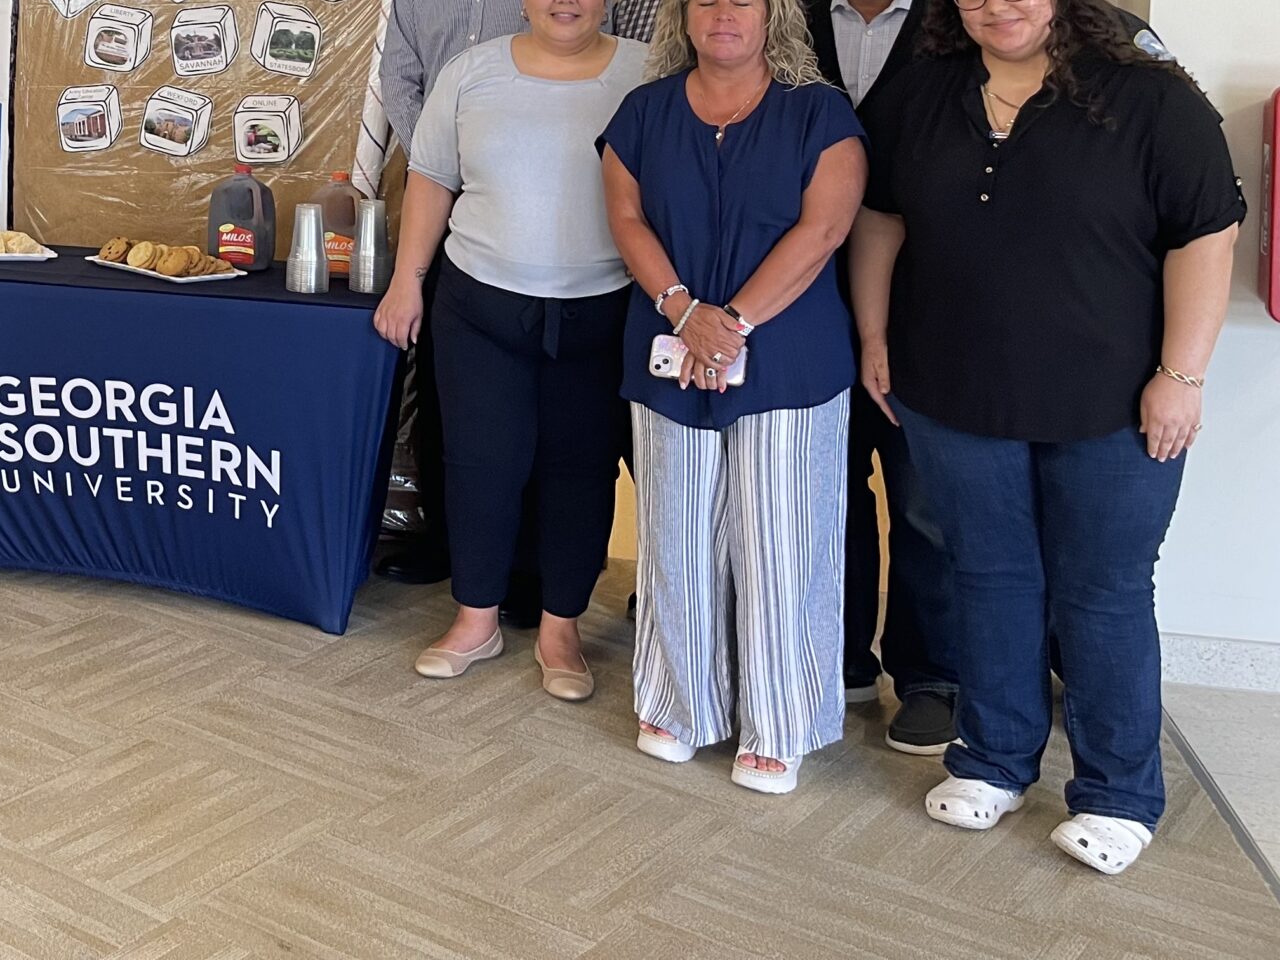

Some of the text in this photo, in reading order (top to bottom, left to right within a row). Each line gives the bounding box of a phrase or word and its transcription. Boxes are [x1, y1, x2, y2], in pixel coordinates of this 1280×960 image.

[110, 8, 134, 18] LIBERTY
[179, 55, 224, 71] SAVANNAH
[166, 91, 199, 106] WEXFORD
[0, 469, 280, 529] UNIVERSITY
